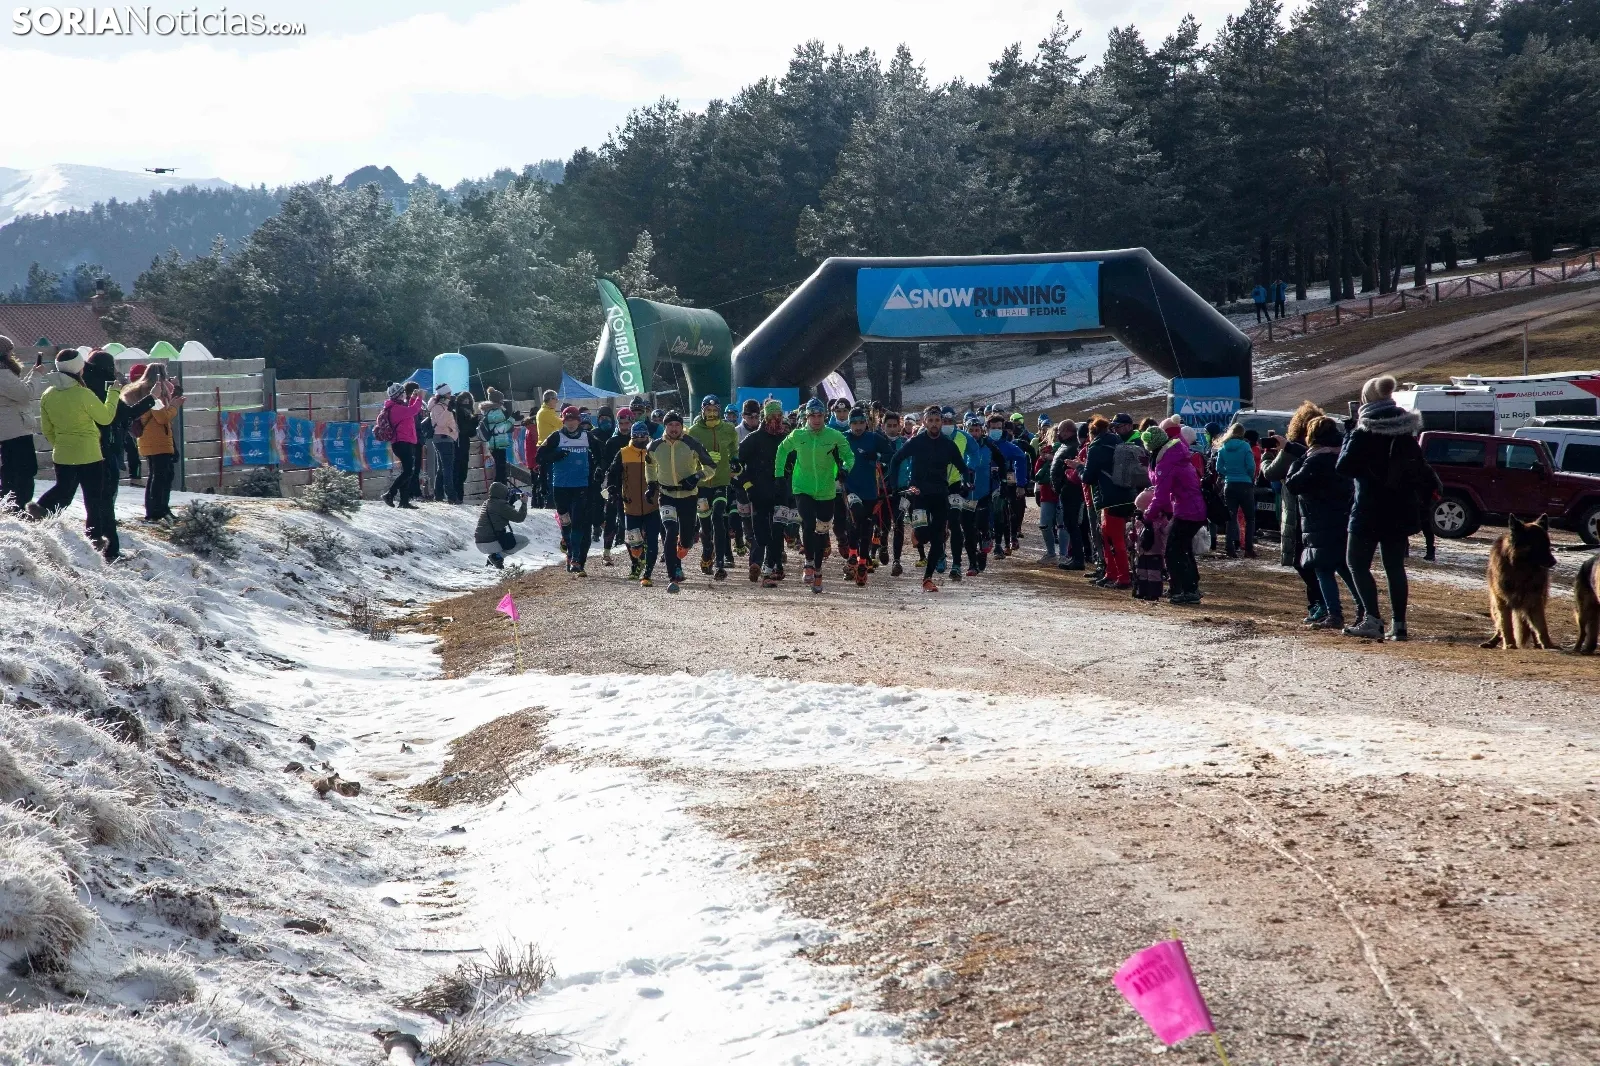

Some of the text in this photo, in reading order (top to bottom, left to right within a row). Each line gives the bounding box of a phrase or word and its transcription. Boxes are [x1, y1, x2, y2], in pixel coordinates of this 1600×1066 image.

[909, 285, 1066, 308] SNOWRUNNING
[999, 308, 1026, 317] TRAIL
[1029, 306, 1067, 316] FEDME
[1515, 390, 1564, 398] AMBULANCIA
[1193, 400, 1233, 413] SNOW
[1512, 411, 1531, 420] Roja
